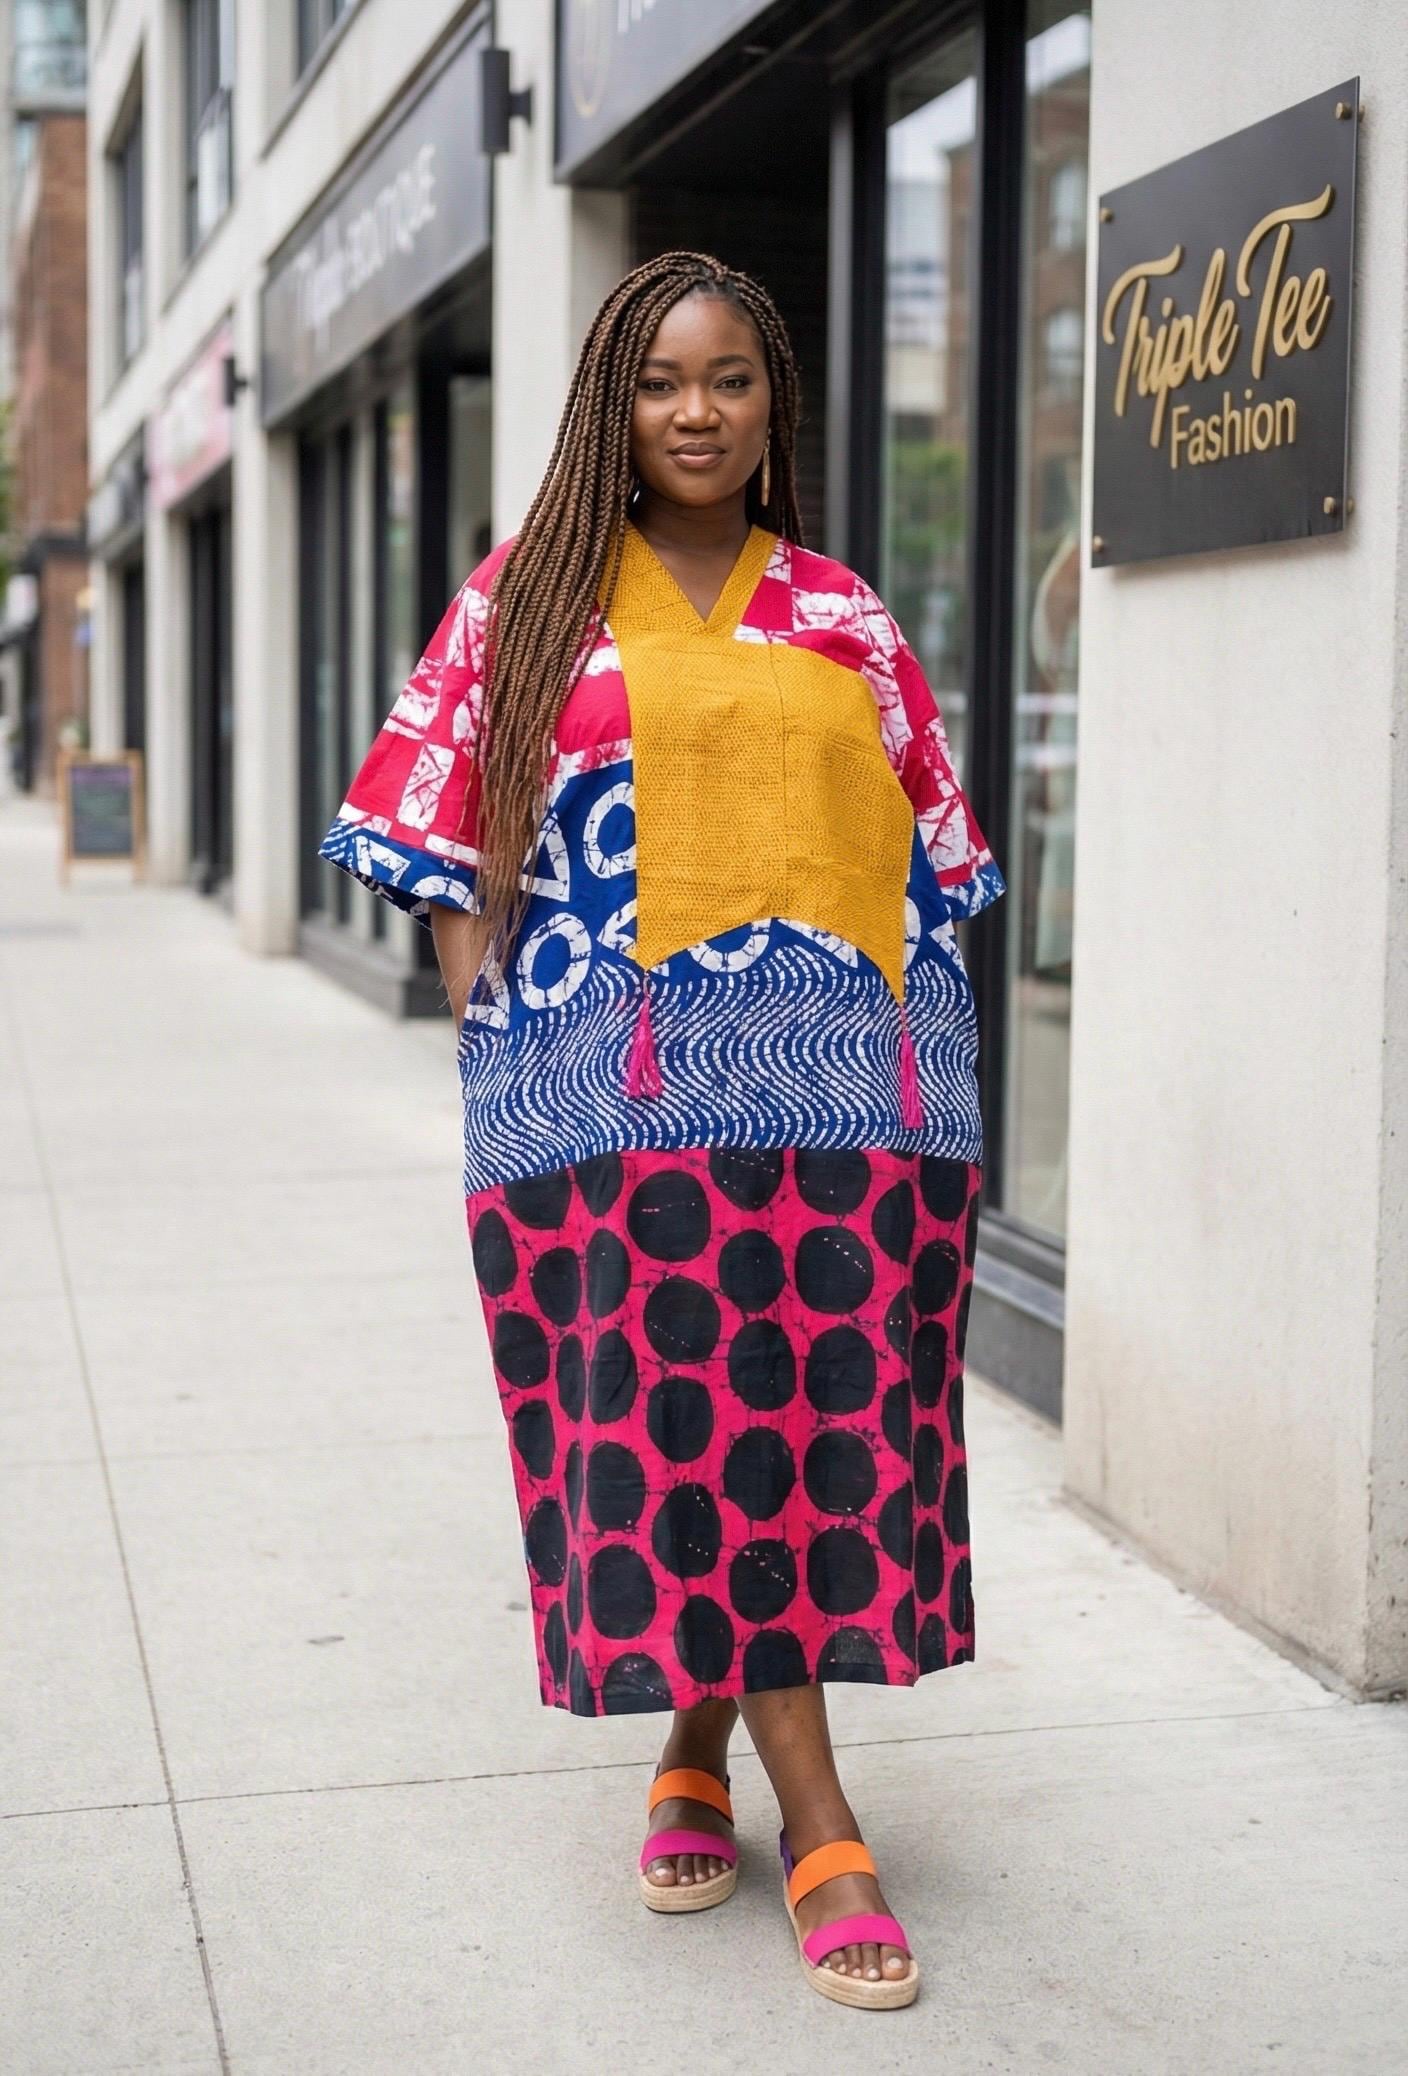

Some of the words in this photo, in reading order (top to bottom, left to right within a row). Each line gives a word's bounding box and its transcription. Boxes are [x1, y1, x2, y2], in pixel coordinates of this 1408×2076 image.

[1102, 244, 1238, 447] Triple
[1236, 184, 1332, 379] Tee
[1170, 389, 1296, 468] Fashion
